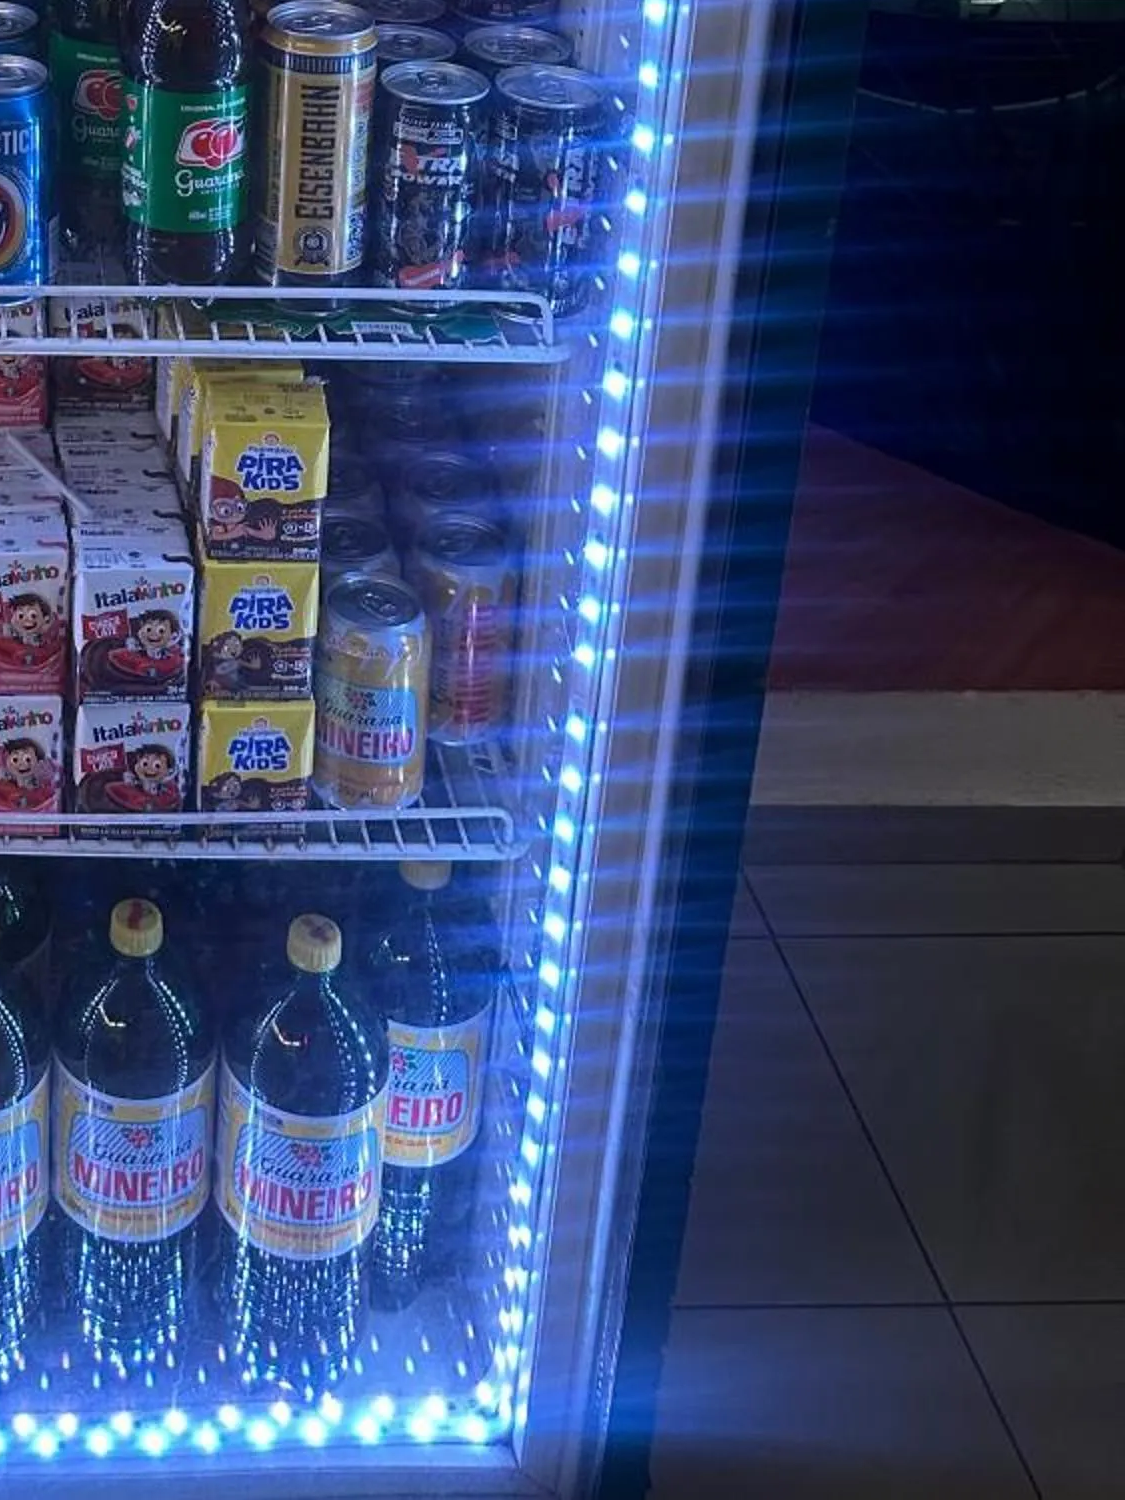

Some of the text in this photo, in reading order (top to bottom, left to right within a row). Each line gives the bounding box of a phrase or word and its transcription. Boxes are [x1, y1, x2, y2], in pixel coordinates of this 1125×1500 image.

[294, 83, 341, 220] EISENBAHN
[73, 1144, 204, 1202] MINEIRO
[239, 1157, 373, 1221] MINEIRO
